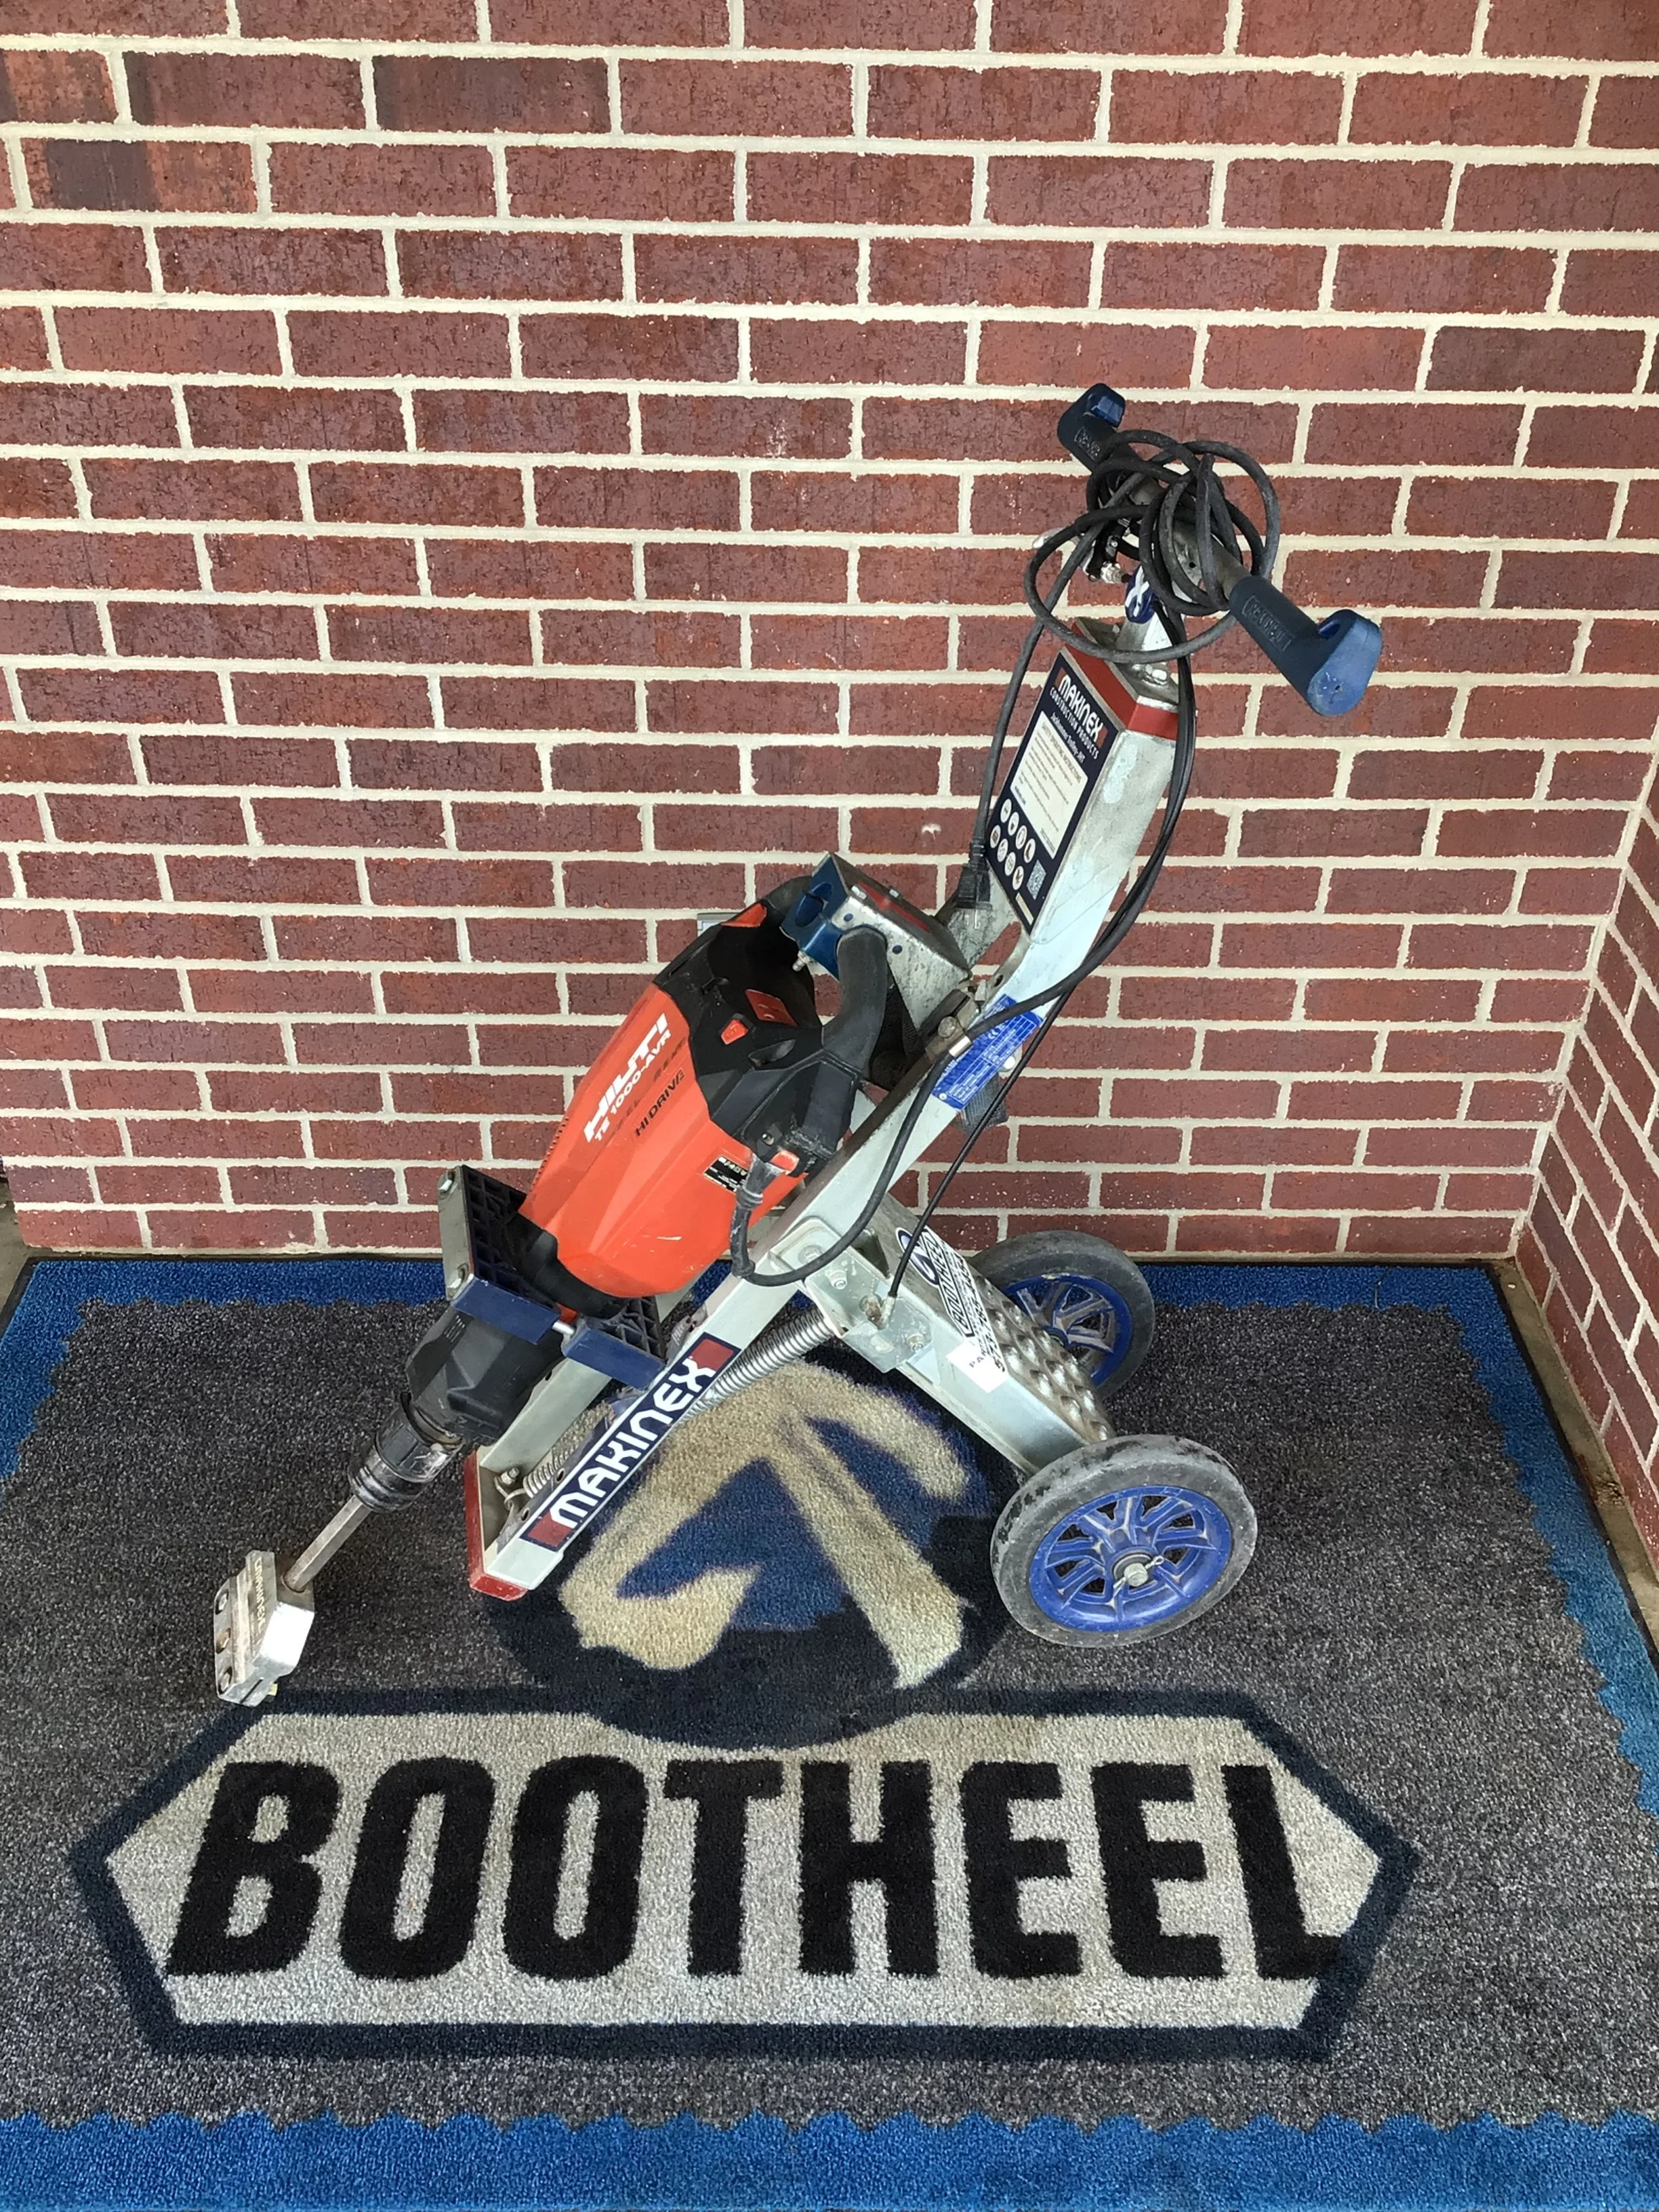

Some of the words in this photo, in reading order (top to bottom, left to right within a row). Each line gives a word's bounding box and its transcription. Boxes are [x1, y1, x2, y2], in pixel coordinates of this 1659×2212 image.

[1050, 687, 1080, 731] CONSTRUCTION
[1076, 725, 1099, 760] PRODUCTS
[1058, 674, 1104, 743] MAKINEX
[583, 1013, 668, 1143] HILTI
[594, 1116, 610, 1141] TE
[611, 1028, 672, 1115] 1000-AVR
[926, 1234, 969, 1330] BOOTHEEL
[549, 1357, 716, 1529] MAKINEX
[163, 1753, 1346, 1983] BOOTHEEL
